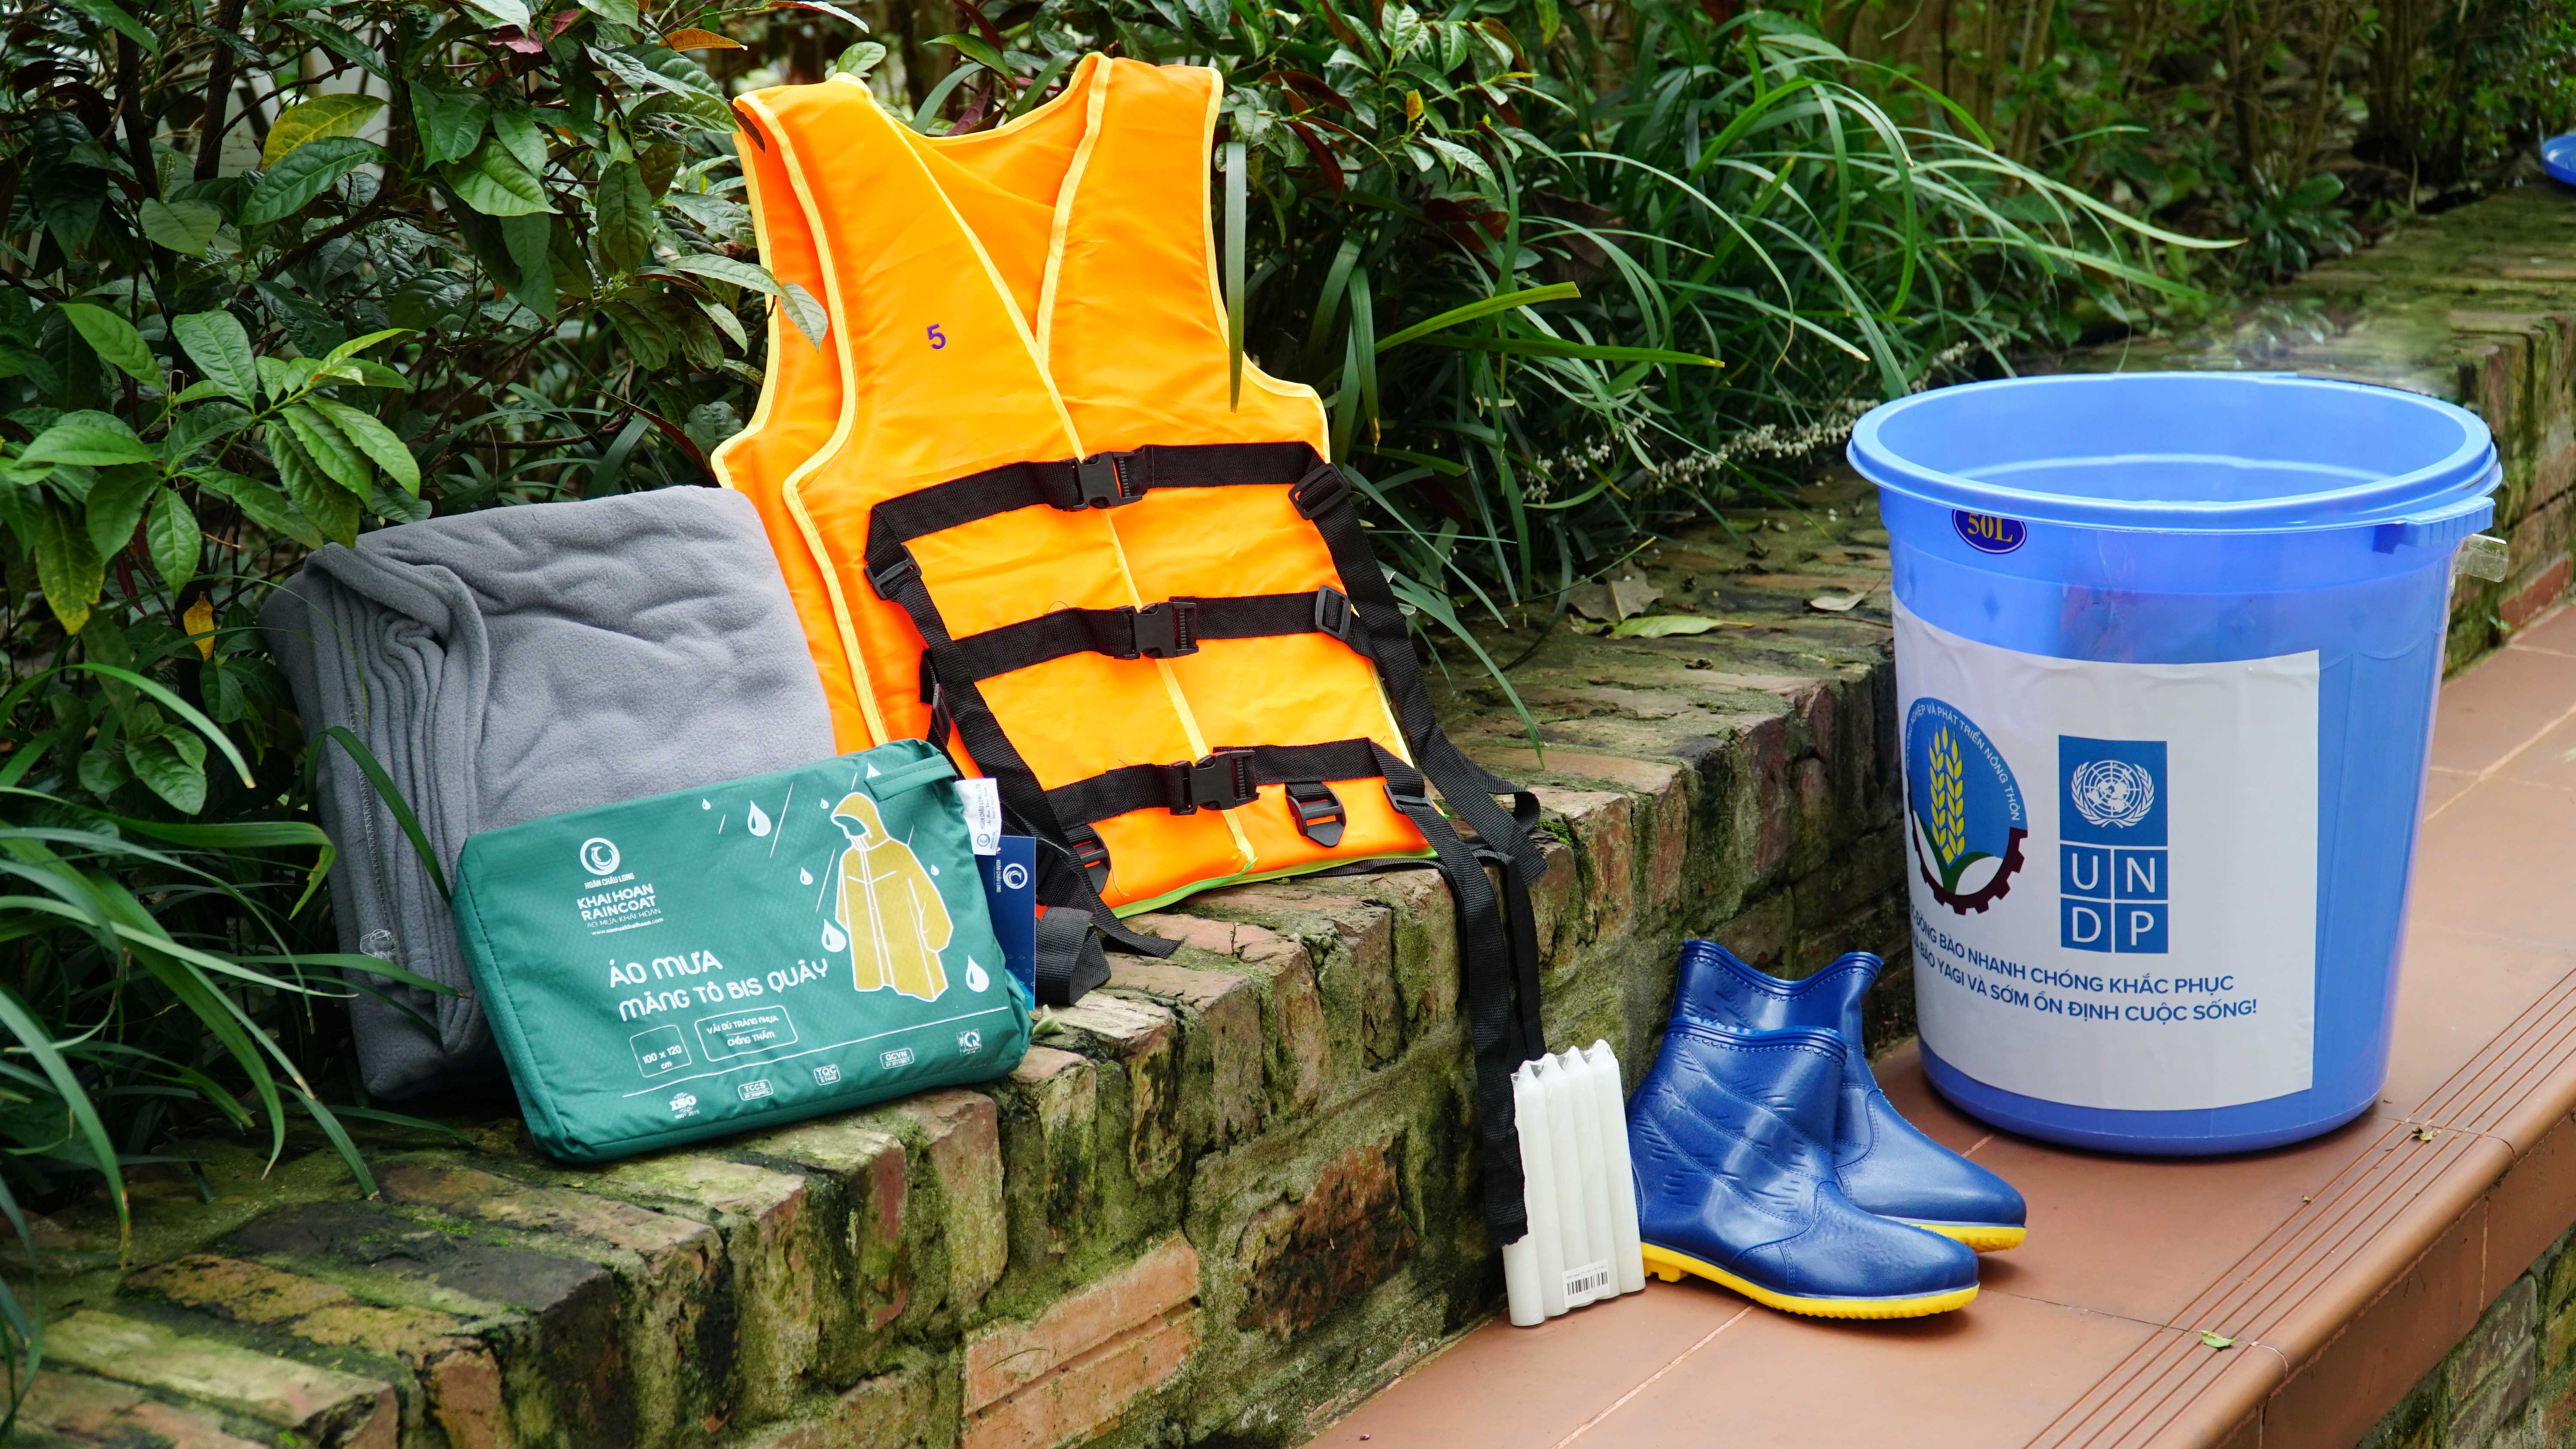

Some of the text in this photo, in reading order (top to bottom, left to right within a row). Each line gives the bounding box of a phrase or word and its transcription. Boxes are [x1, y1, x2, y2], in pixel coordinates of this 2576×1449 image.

[927, 323, 946, 349] 5
[1967, 512, 2013, 543] 50L
[1926, 702, 1937, 715] VÀ
[1937, 706, 1959, 725] PHÁT
[1960, 720, 1985, 750] TRIỂN
[1984, 748, 2008, 784] NÔNG
[2005, 785, 2020, 821] THÔN
[618, 873, 635, 882] LONG
[577, 883, 655, 910] KHAI HOAN
[581, 895, 656, 921] RAINCOAT
[591, 918, 664, 936] www.aomuakhaihoan.com
[651, 950, 723, 980] MƯA
[1939, 932, 1965, 958] BÀO
[1968, 947, 2026, 980] NHANH
[2030, 967, 2104, 992] CHÓNG
[2109, 973, 2169, 994] KHẮC
[2175, 975, 2234, 996] PHỤC
[692, 981, 724, 1003] TÔ
[726, 978, 764, 1000] BIS
[1937, 957, 1965, 986] YAGI
[1967, 973, 1987, 997] VÀ
[1990, 984, 2029, 1008] SỚM
[2034, 991, 2063, 1015] ỔN
[2067, 1001, 2119, 1022] ĐỊNH
[2125, 1002, 2188, 1025] CUỘC
[2193, 999, 2257, 1021] SỐNG!
[642, 1052, 658, 1064] 100
[666, 1045, 682, 1056] 120
[660, 1061, 672, 1070] cm
[885, 1051, 908, 1062] QCVN
[816, 1066, 837, 1077] TQC
[744, 1083, 766, 1094] TCCS
[669, 1094, 697, 1111] ISO
